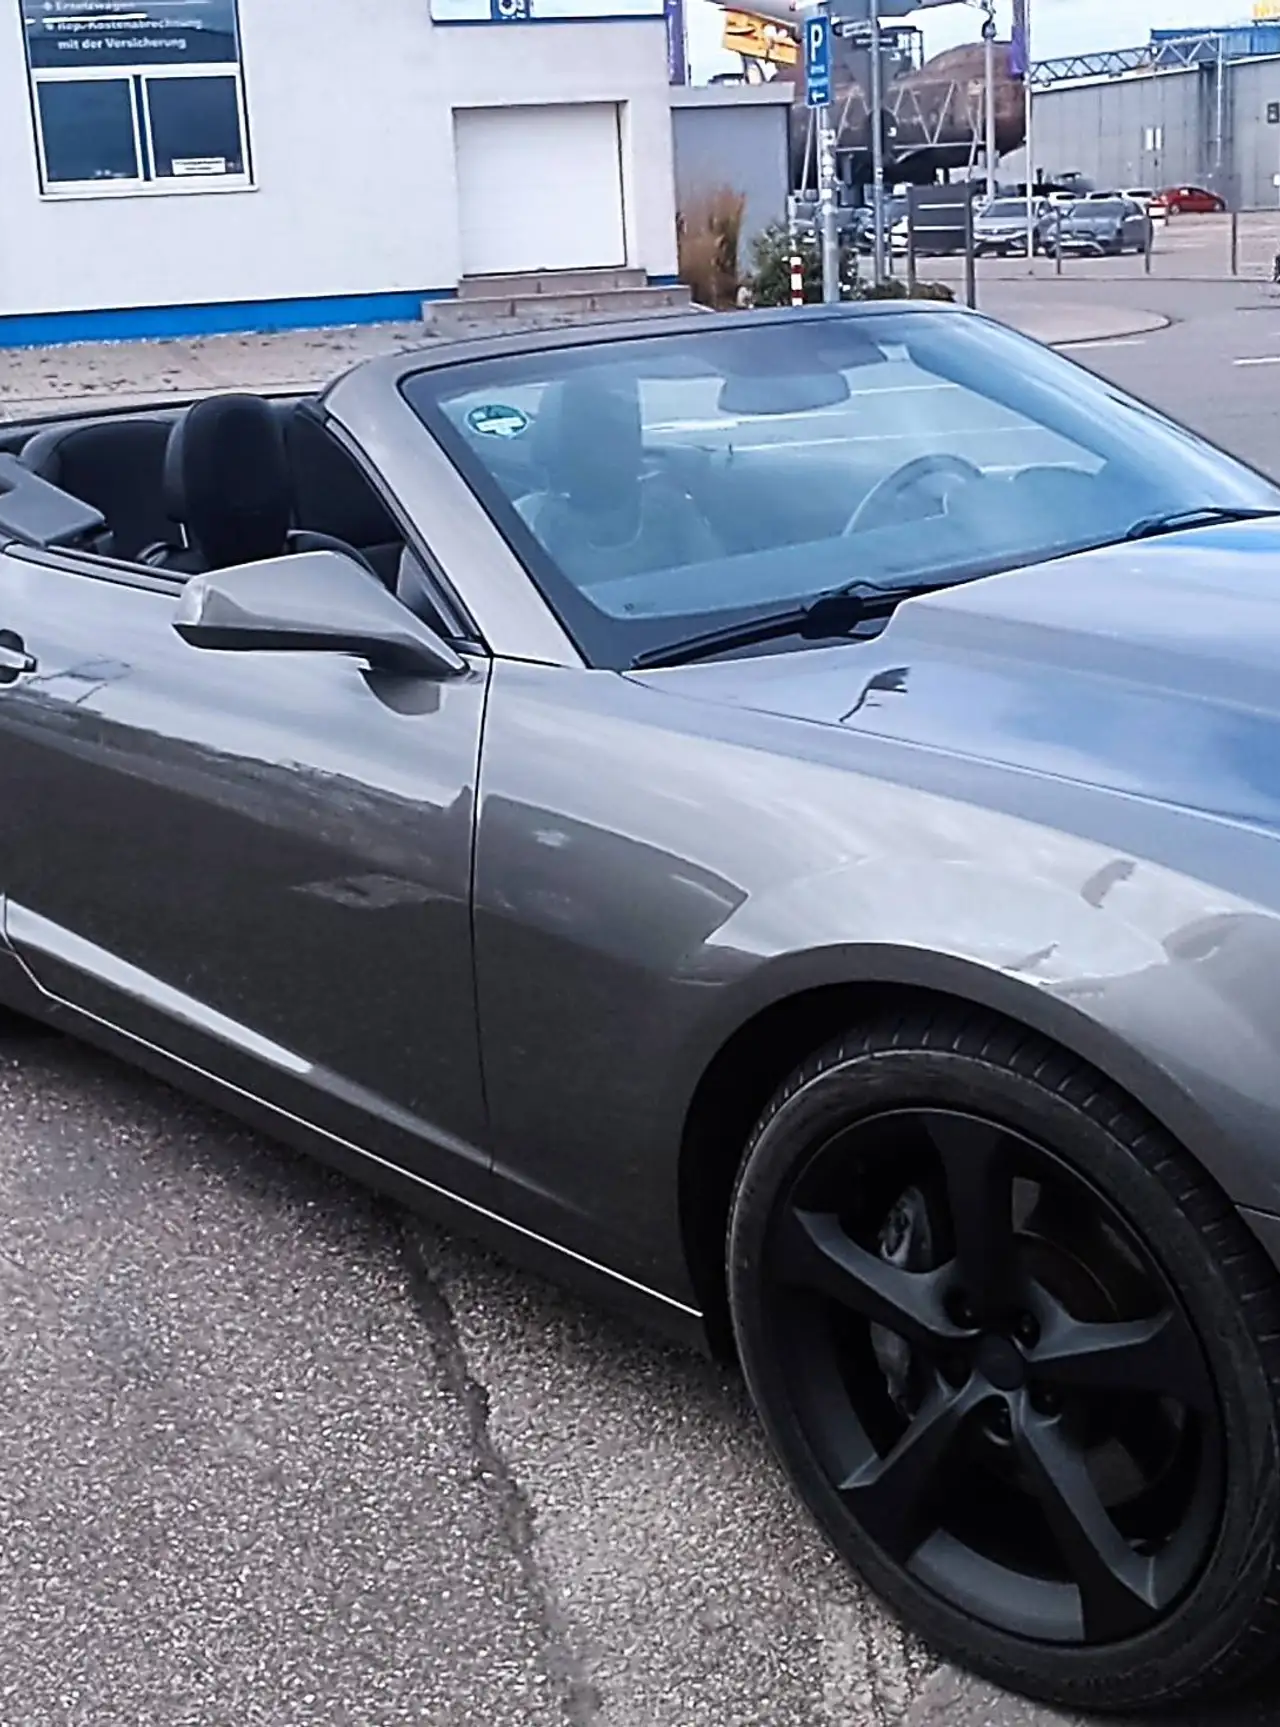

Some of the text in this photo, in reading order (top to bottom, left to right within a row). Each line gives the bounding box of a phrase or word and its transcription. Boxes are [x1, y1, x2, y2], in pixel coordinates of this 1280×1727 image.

[58, 37, 186, 50] mit der Versicherung
[811, 24, 823, 62] P
